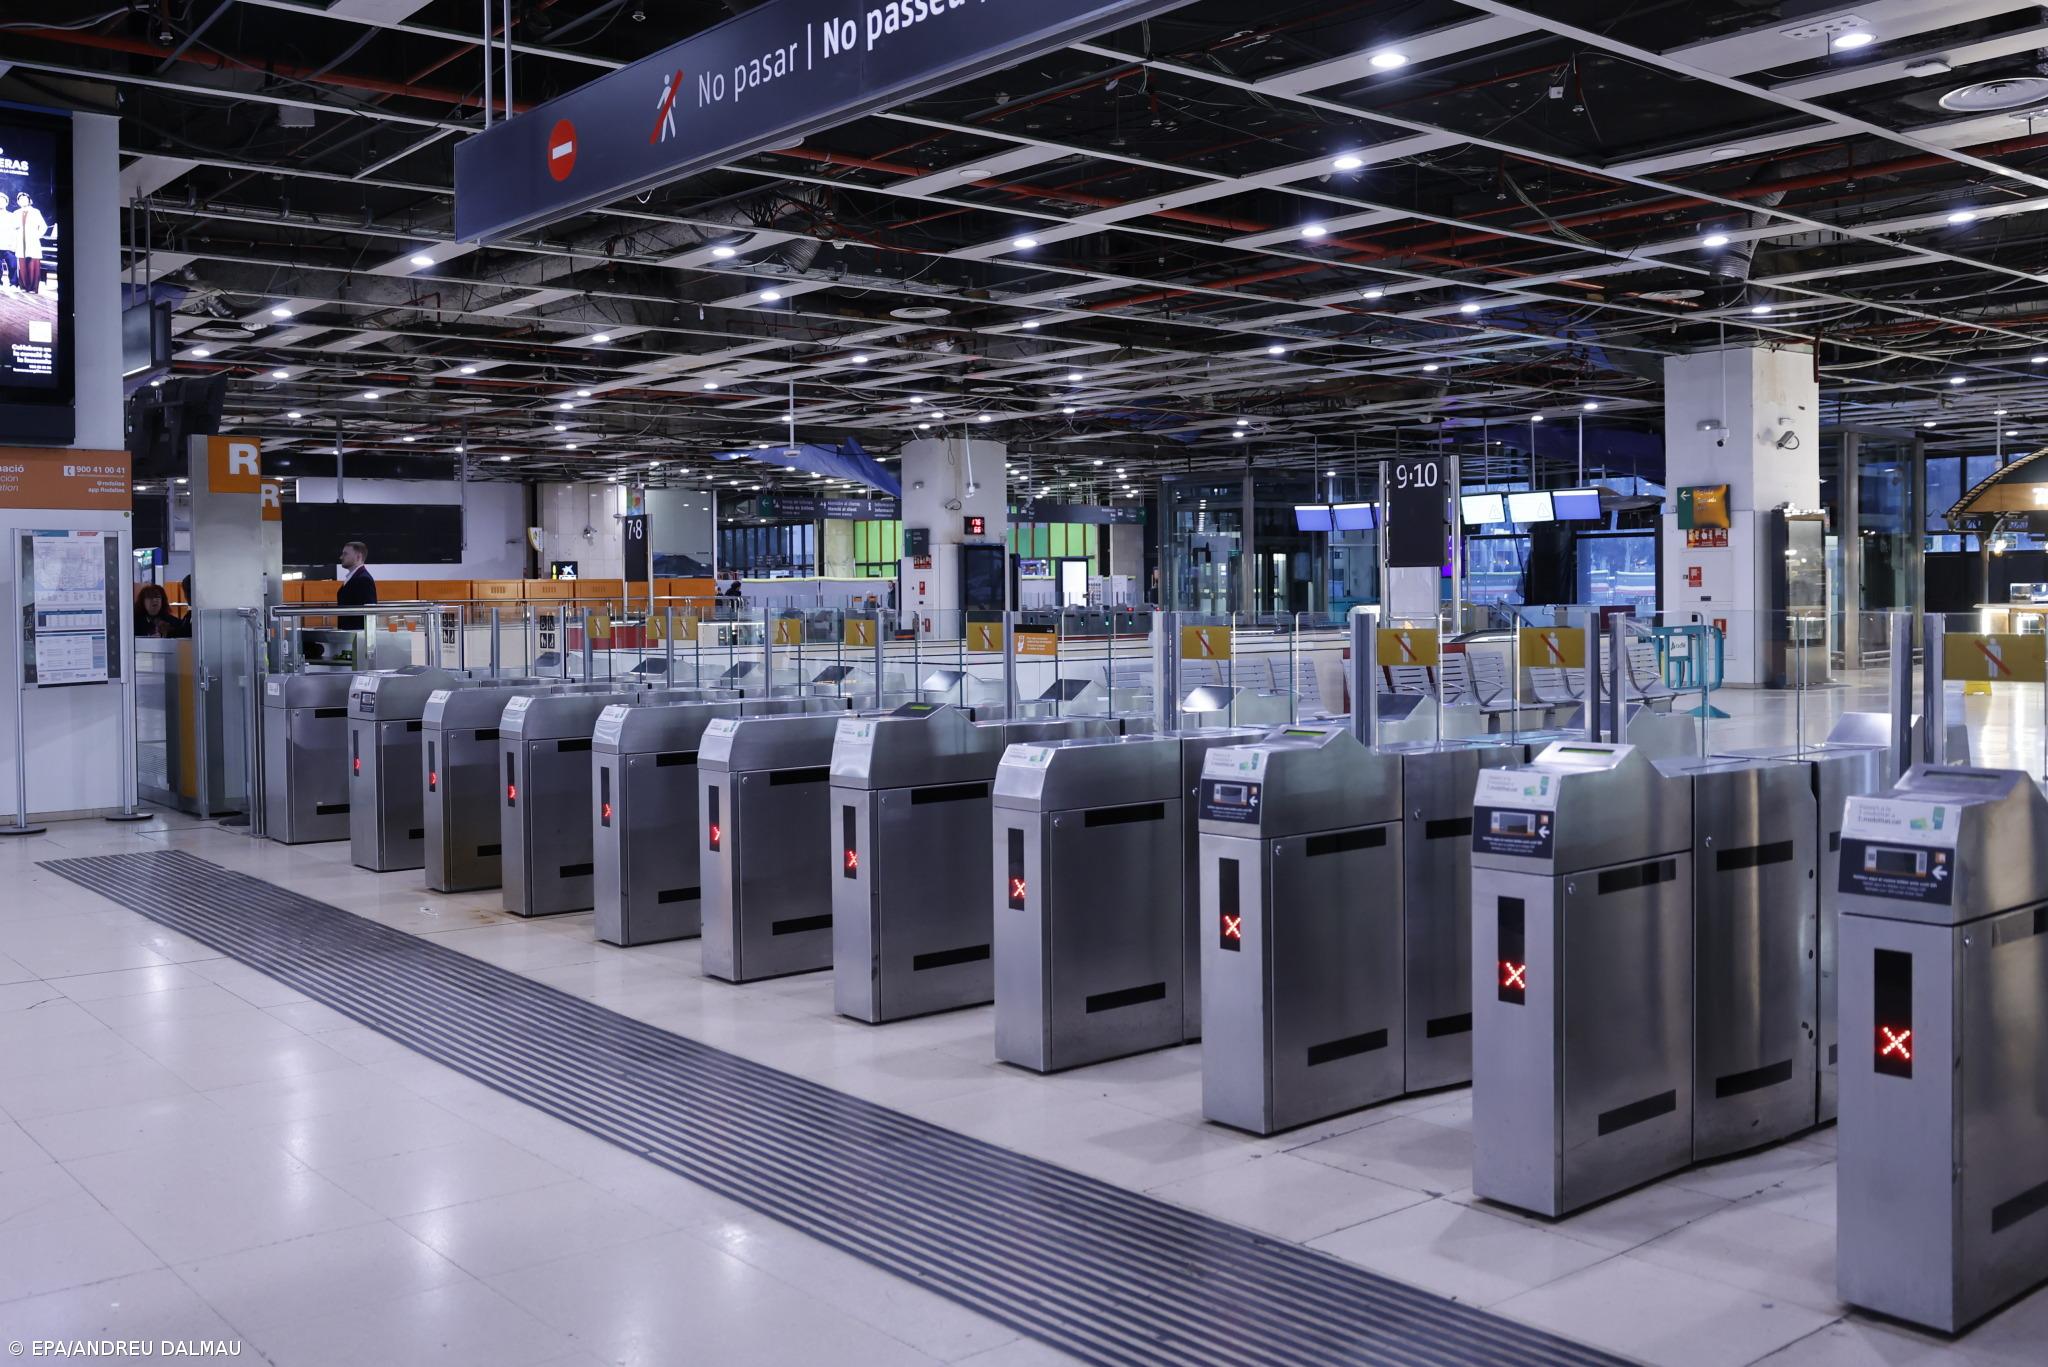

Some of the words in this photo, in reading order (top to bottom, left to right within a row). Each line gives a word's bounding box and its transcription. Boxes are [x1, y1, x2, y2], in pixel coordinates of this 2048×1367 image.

[698, 71, 725, 108] No
[734, 42, 797, 102] pasar
[823, 17, 857, 58] No
[0, 464, 24, 473] ació
[229, 443, 259, 475] R
[261, 484, 280, 508] R
